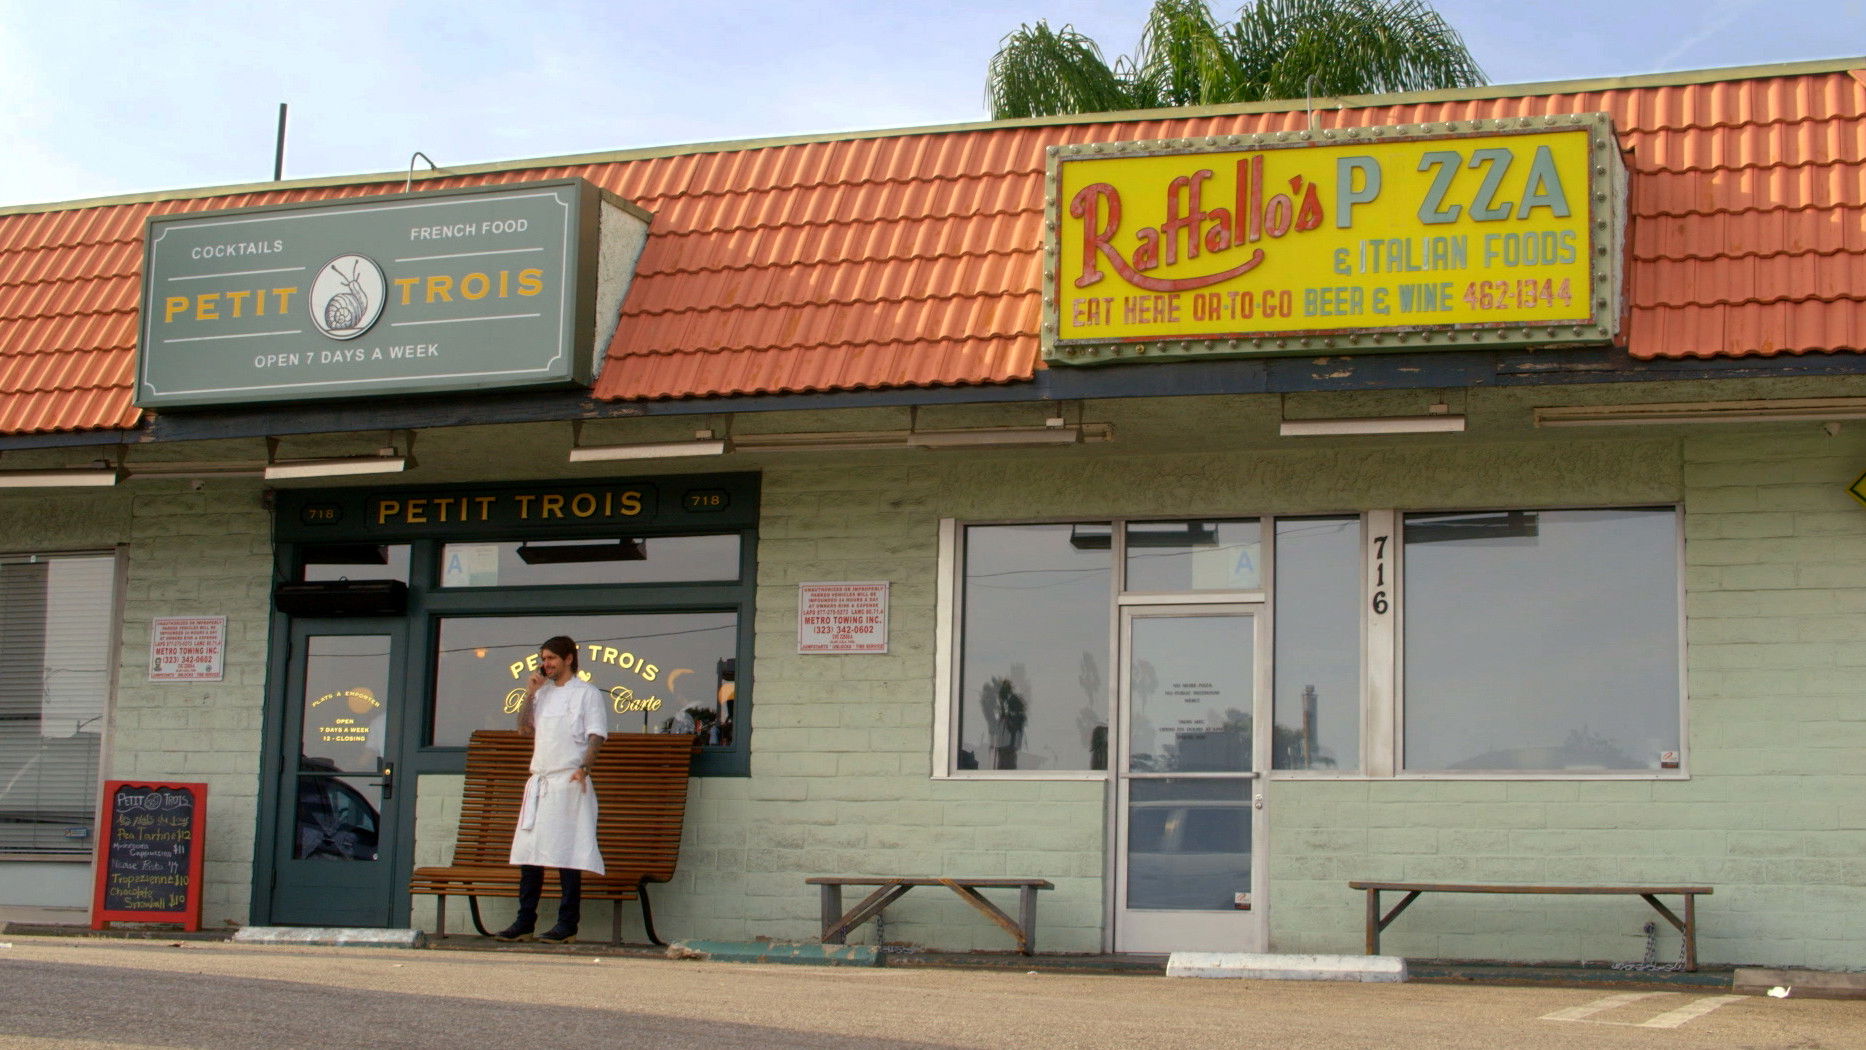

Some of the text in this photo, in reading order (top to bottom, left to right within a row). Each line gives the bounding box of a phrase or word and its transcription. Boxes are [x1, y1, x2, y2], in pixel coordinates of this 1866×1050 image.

[411, 218, 529, 242] FRENCH FOOD
[1070, 154, 1325, 292] Raffallo's
[191, 239, 284, 260] COCKTAILS
[1333, 229, 1577, 276] & ITALIAN FOODS
[164, 267, 544, 323] PETIT TROIS
[1072, 296, 1116, 328] EAT
[1123, 293, 1182, 325] HERE
[1303, 286, 1366, 318] BEER
[1371, 285, 1391, 316] &
[1398, 280, 1454, 314] WINE
[1462, 277, 1573, 311] 462-1344
[254, 343, 440, 369] OPEN 7 DAYS A WEEK
[308, 490, 721, 525] 718 PETIT TROIS 718
[447, 553, 463, 576] A
[1235, 549, 1255, 576] A
[1372, 536, 1389, 615] 716
[804, 616, 882, 625] METRO TOWING INC.
[813, 625, 874, 634] (323) 342-0602
[156, 647, 219, 656] METRO TOWING INC.
[162, 656, 179, 664] (323)
[589, 644, 660, 682] TROIS
[311, 692, 334, 708] PLATS
[609, 686, 663, 714] Carte
